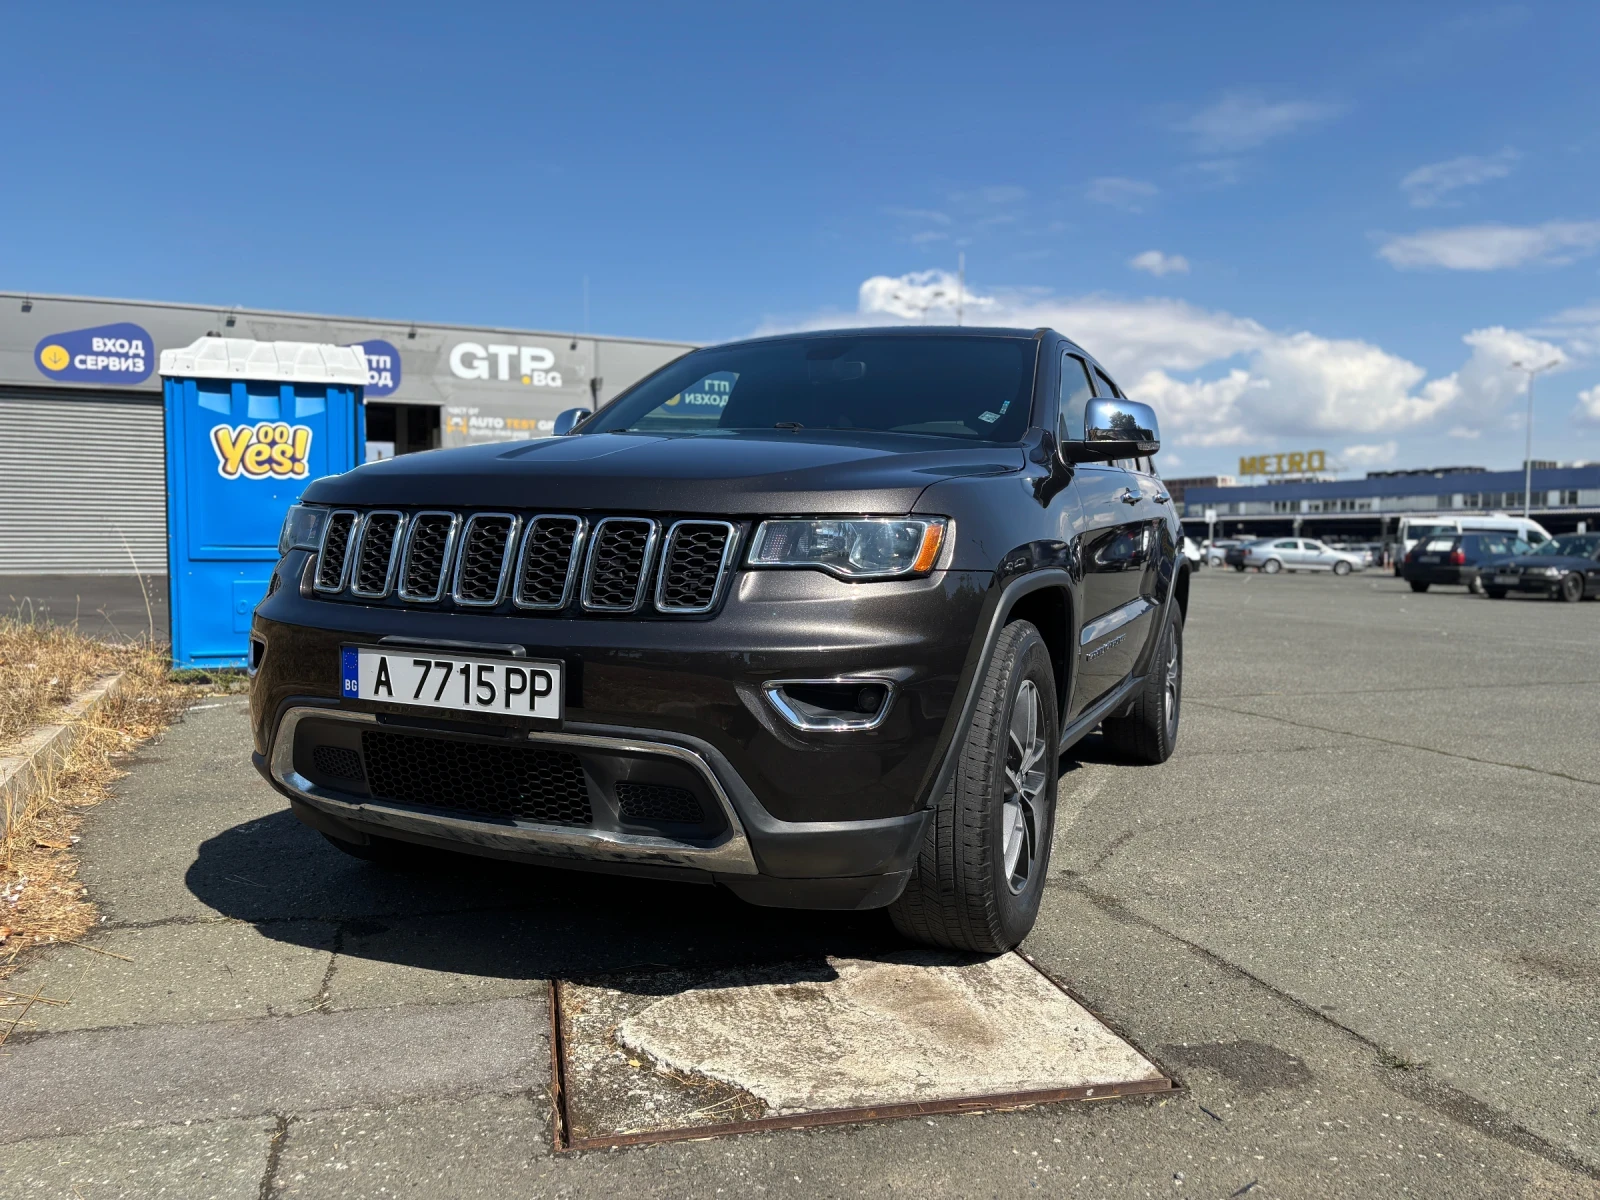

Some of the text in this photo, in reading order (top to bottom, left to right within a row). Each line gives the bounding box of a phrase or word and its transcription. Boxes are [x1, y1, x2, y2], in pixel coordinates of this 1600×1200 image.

[92, 337, 145, 357] ВХОД
[74, 354, 145, 372] СЕРВИЗ
[704, 379, 729, 392] ГТП
[684, 393, 729, 407] ИЗХОД
[469, 416, 504, 429] AUTO
[506, 418, 536, 430] TEST
[214, 426, 309, 475] Yes!
[1239, 450, 1326, 475] METRO
[345, 678, 358, 692] BG
[373, 656, 394, 697] A
